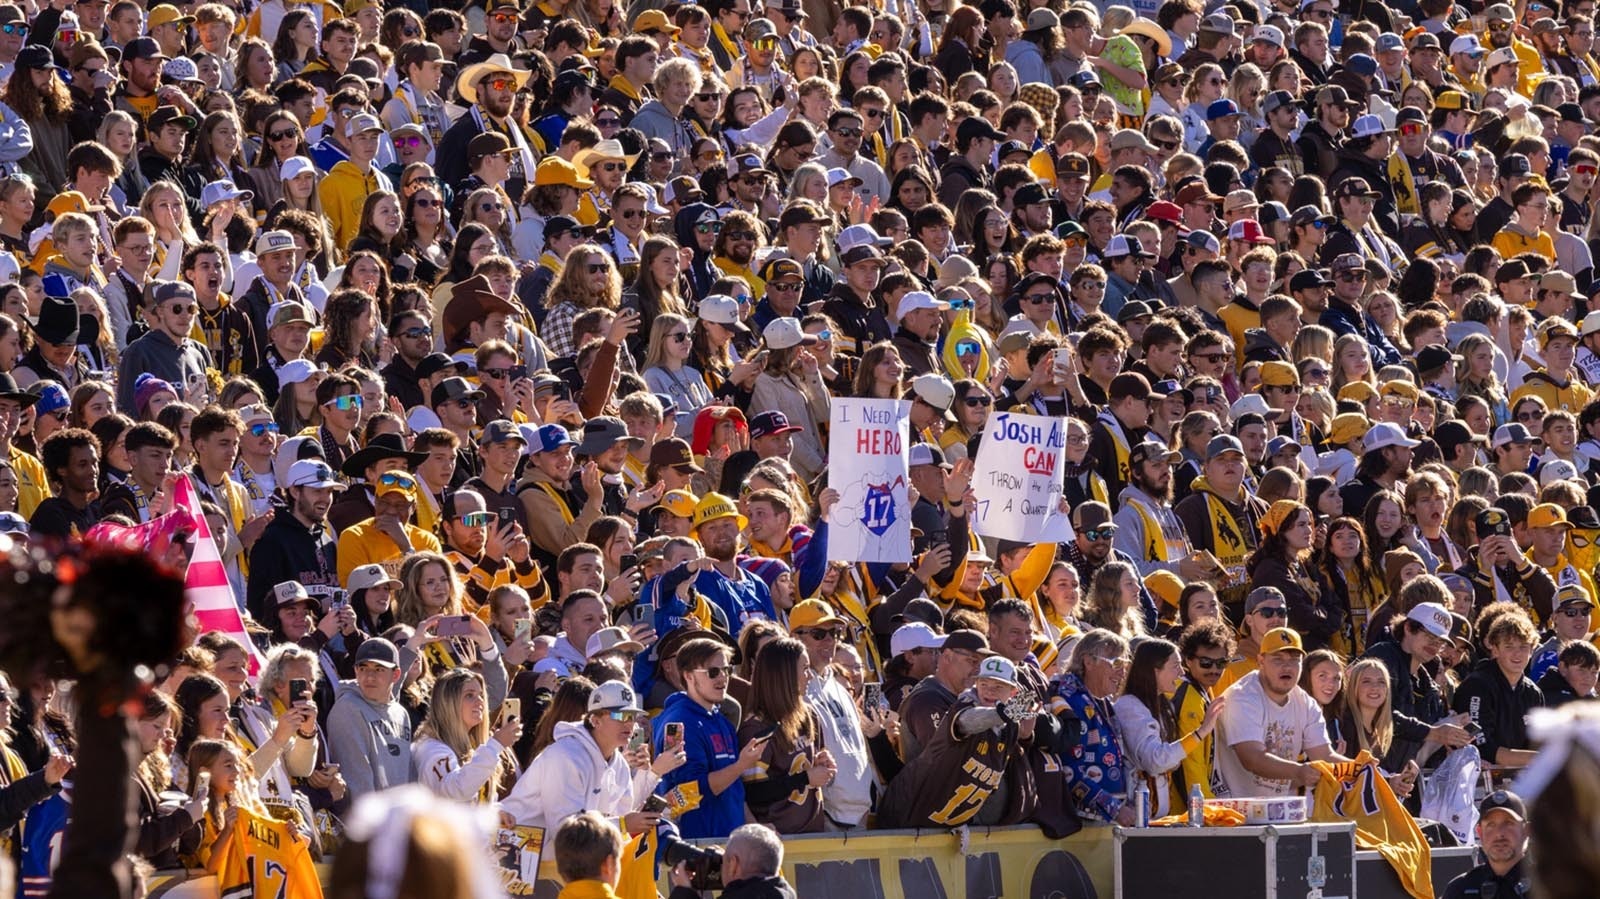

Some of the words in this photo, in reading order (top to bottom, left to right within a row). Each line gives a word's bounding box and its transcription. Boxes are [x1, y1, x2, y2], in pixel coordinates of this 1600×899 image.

[839, 405, 850, 423] I
[863, 406, 891, 424] NEED
[993, 413, 1042, 444] JOSH
[857, 428, 902, 456] HERO
[1024, 446, 1056, 471] CAN
[989, 470, 1023, 490] THROW
[867, 495, 891, 528] 17
[1002, 497, 1013, 512] A
[986, 660, 1003, 673] CL
[433, 757, 452, 782] 17
[1332, 763, 1362, 778] ALLE
[928, 783, 992, 825] 17
[247, 819, 280, 849] ALLEN
